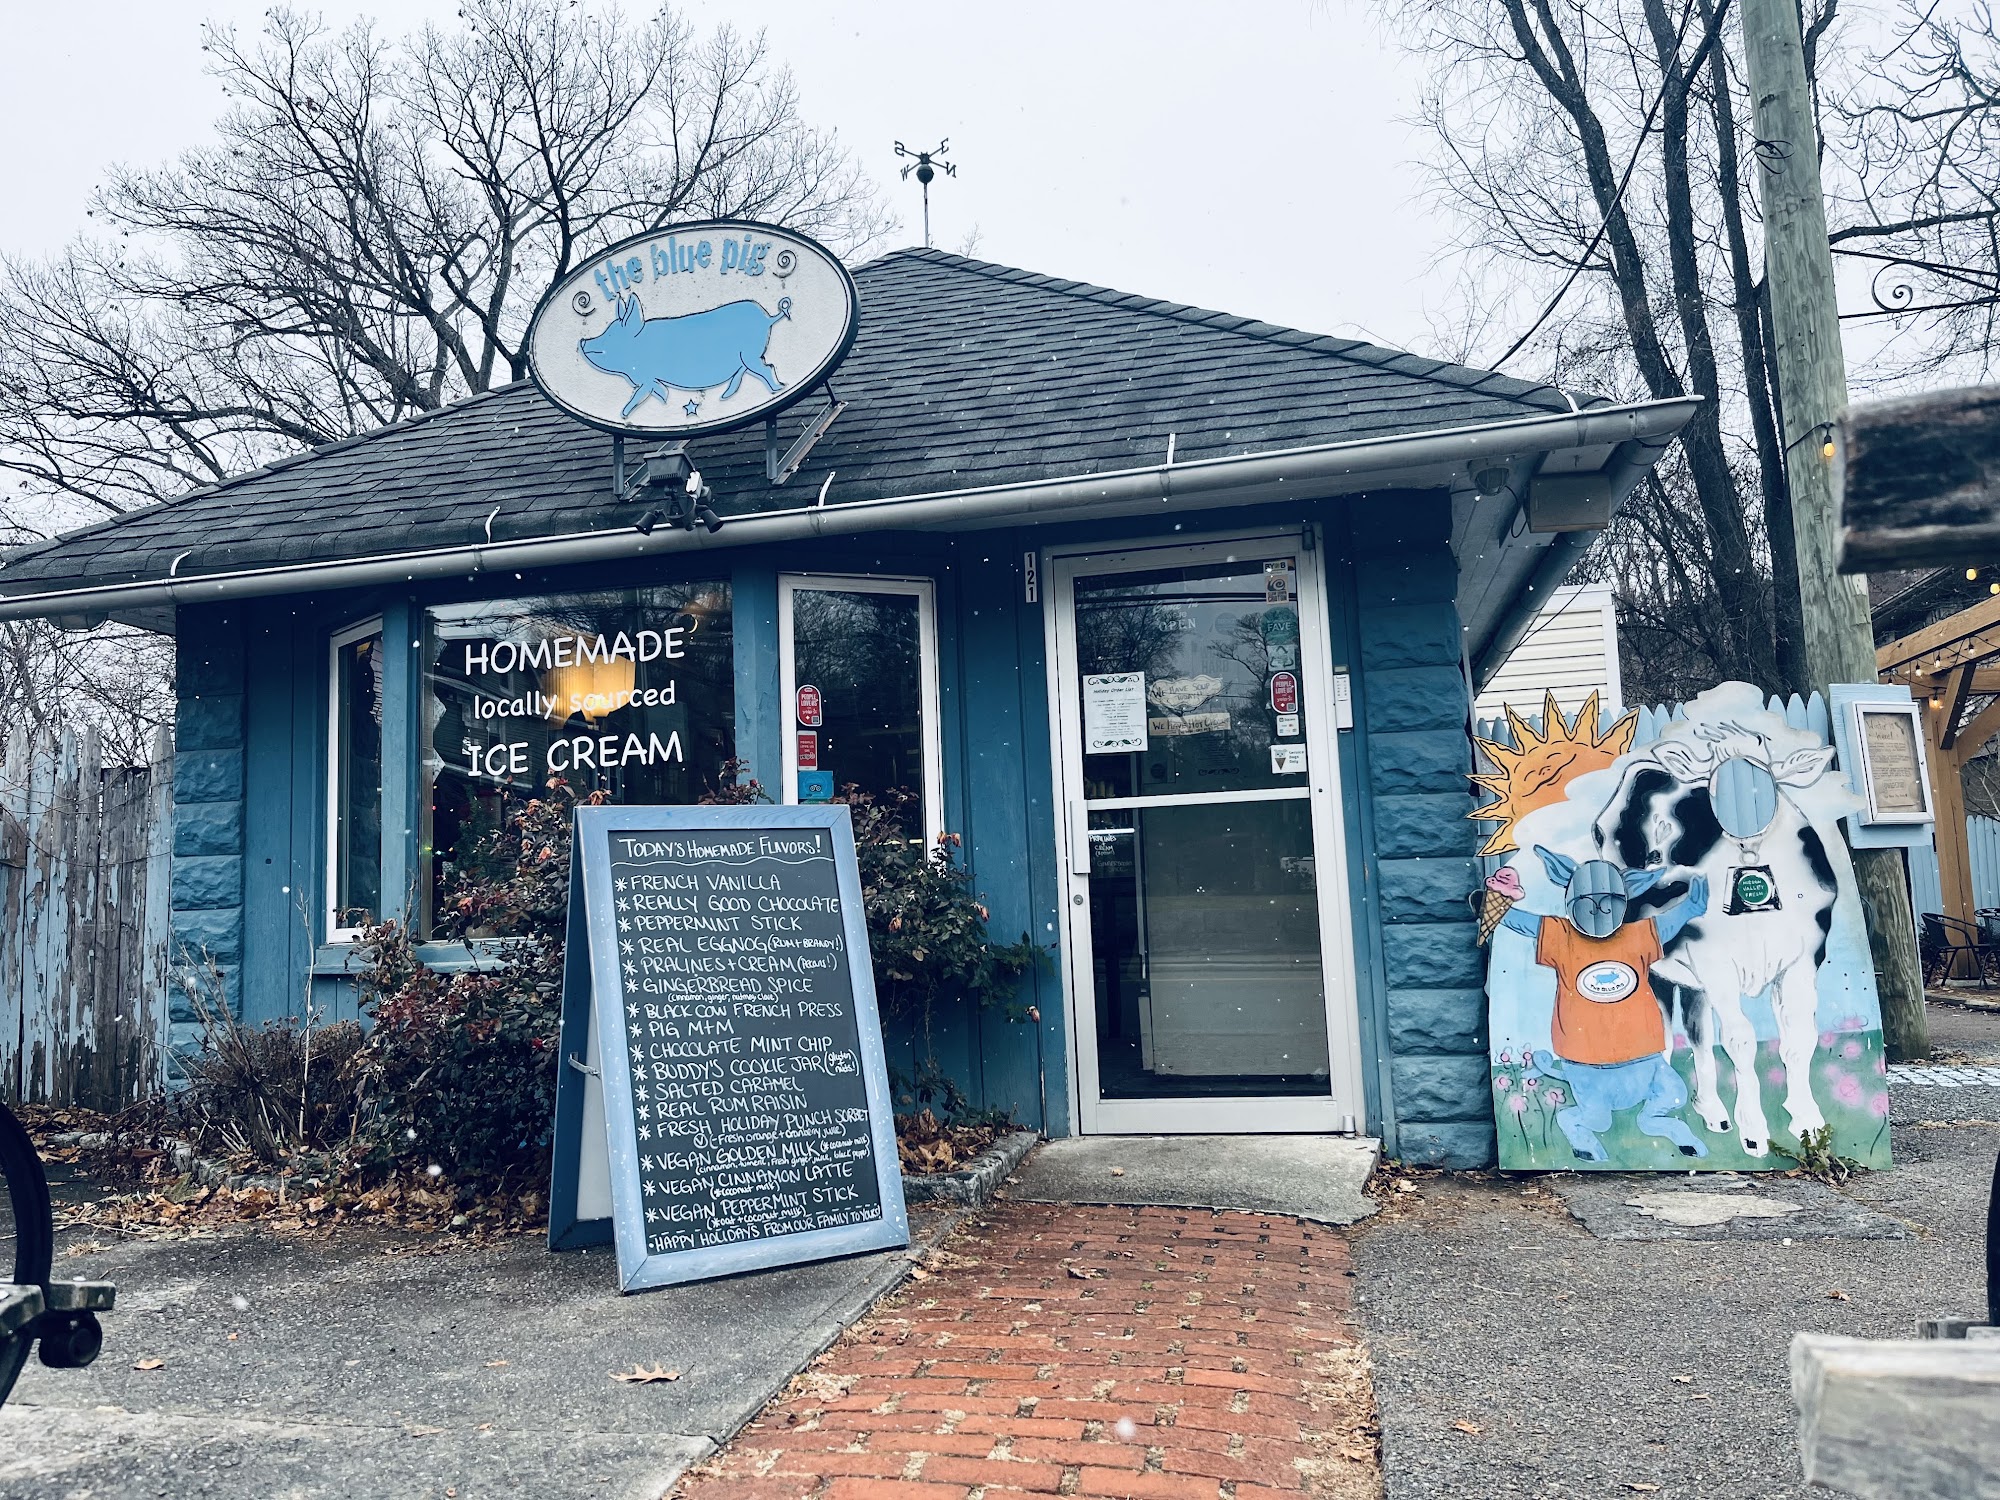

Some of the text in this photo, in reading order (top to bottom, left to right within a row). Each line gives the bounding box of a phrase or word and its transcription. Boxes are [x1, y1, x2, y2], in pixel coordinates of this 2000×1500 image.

[594, 234, 772, 301] the blue pig
[1027, 553, 1035, 602] 121
[1159, 618, 1196, 632] OPEN
[1268, 622, 1291, 632] FAVE
[465, 627, 685, 676] HOMEMADE
[474, 680, 676, 720] locally sourced
[1170, 685, 1189, 694] HAVE
[1193, 683, 1210, 691] SOUP
[467, 730, 683, 777] ICE CREAM
[617, 834, 821, 858] TODAY'S HOMEMADE FLAVORS!
[630, 874, 781, 891] FRENCH VANILLA
[632, 894, 839, 913] REALLY GOOD CHOCOLATE
[634, 915, 802, 932] PEPPERMINT STICK
[637, 937, 692, 954] REAL
[697, 936, 767, 954] EGGNOG
[640, 956, 726, 975] PRALINES
[738, 956, 797, 973] CREAM
[643, 976, 813, 994] GINGERBREAD SPICE
[644, 1001, 843, 1019] BLACK COW FRENCH PRESS
[648, 1020, 680, 1038] PIG
[650, 1036, 832, 1059] CHOCOLATE MINT CHIP
[651, 1059, 724, 1080] BUDDY'S
[730, 1056, 788, 1076] COOKIE
[789, 1055, 825, 1073] JAR
[655, 1076, 804, 1100] SALTED CARAMEL
[656, 1094, 808, 1119] REAL RUM RAISIN
[657, 1108, 868, 1138] FRESH HOLIDAY PUNCH SORBET
[746, 1131, 778, 1144] orange
[656, 1151, 711, 1170] VEGAN
[716, 1144, 776, 1163] GOLDEN
[782, 1140, 820, 1159] MILK
[658, 1161, 854, 1196] VEGAN CINNAMON LATTE
[658, 1184, 859, 1222] VEGAN PEPPERMINT STICK
[655, 1233, 695, 1252] HAPPY
[700, 1224, 760, 1246] HOLIDAYS
[763, 1221, 794, 1236] FROM
[794, 1217, 816, 1230] OUR
[817, 1211, 849, 1228] FAMILY
[850, 1211, 860, 1222] TO
